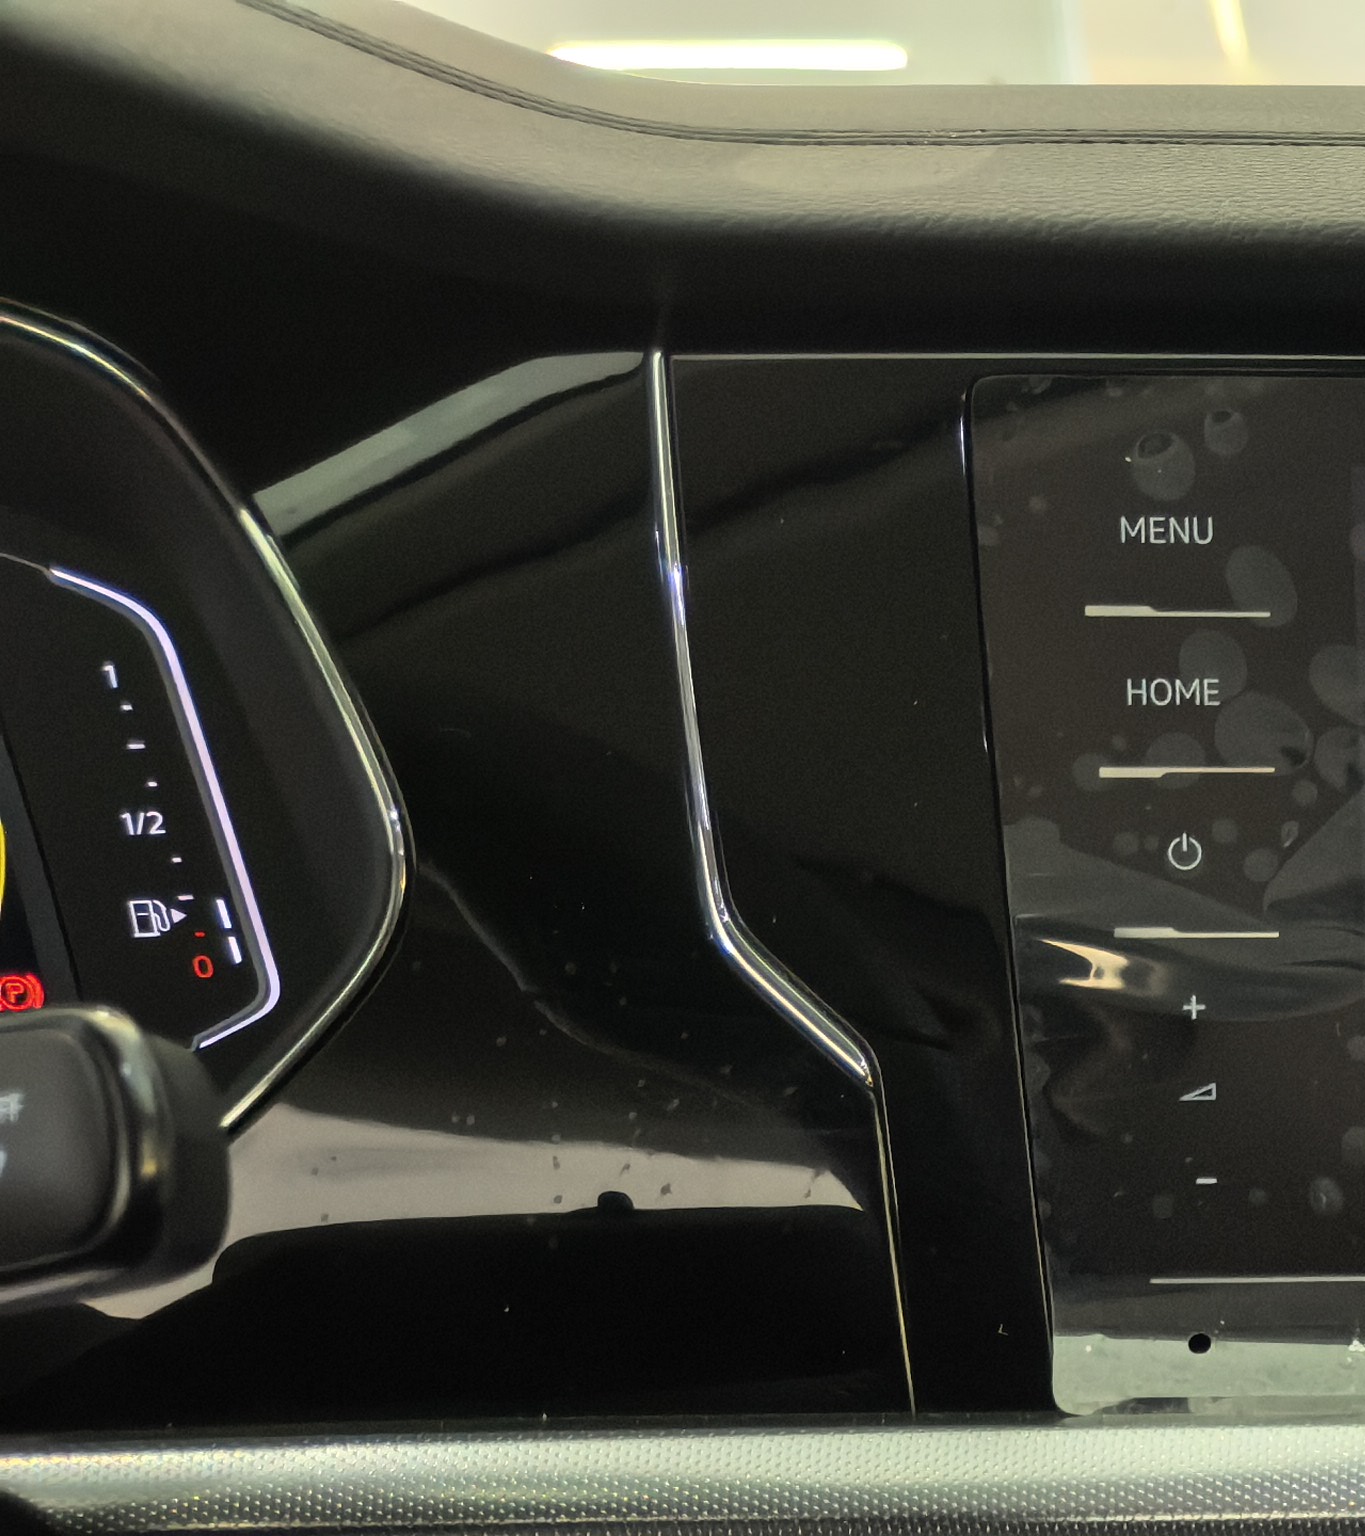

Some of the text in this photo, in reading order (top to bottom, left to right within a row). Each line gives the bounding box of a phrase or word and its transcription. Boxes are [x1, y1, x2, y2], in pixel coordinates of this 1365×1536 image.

[1120, 516, 1214, 545] MENU
[103, 664, 118, 688] 1
[1126, 678, 1221, 706] HOME
[119, 810, 167, 837] 1/2
[192, 955, 215, 979] 0
